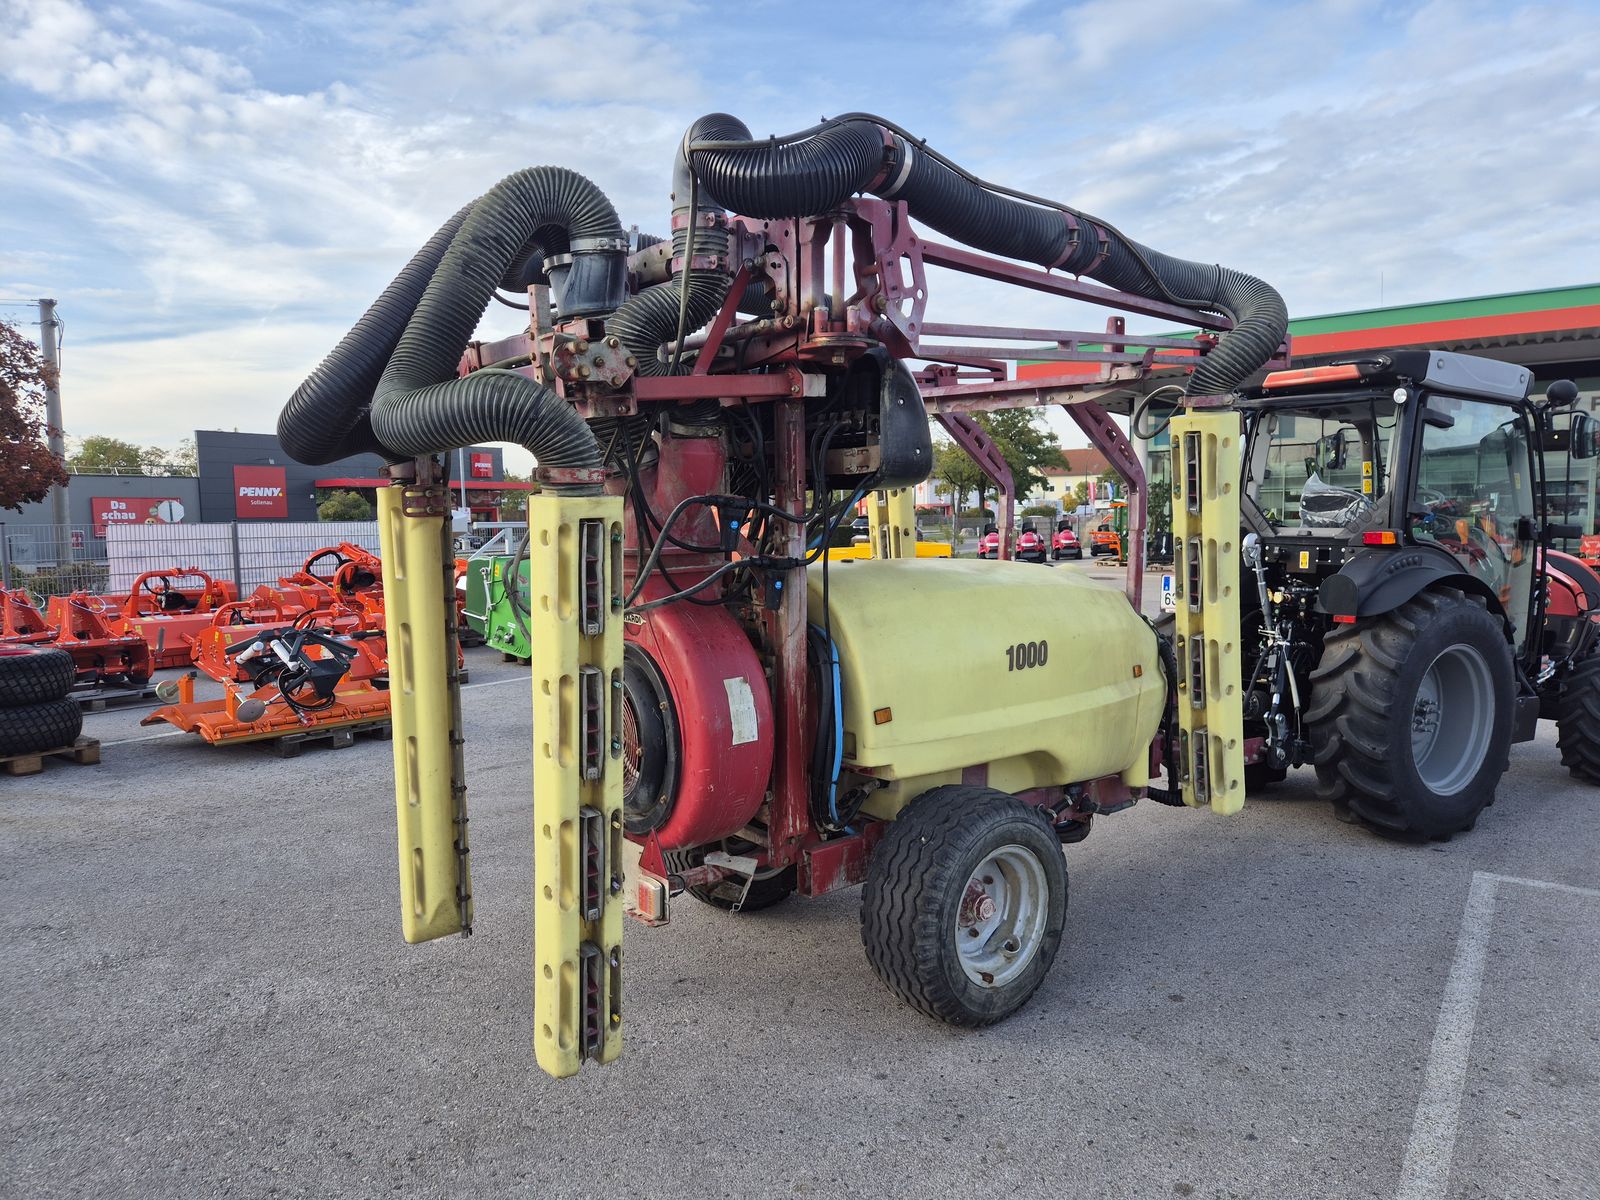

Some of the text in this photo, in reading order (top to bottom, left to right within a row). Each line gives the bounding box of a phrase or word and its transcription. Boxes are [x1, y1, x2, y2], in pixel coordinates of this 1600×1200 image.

[110, 500, 127, 510] Da
[101, 510, 136, 520] schau
[1005, 639, 1048, 672] 1000
